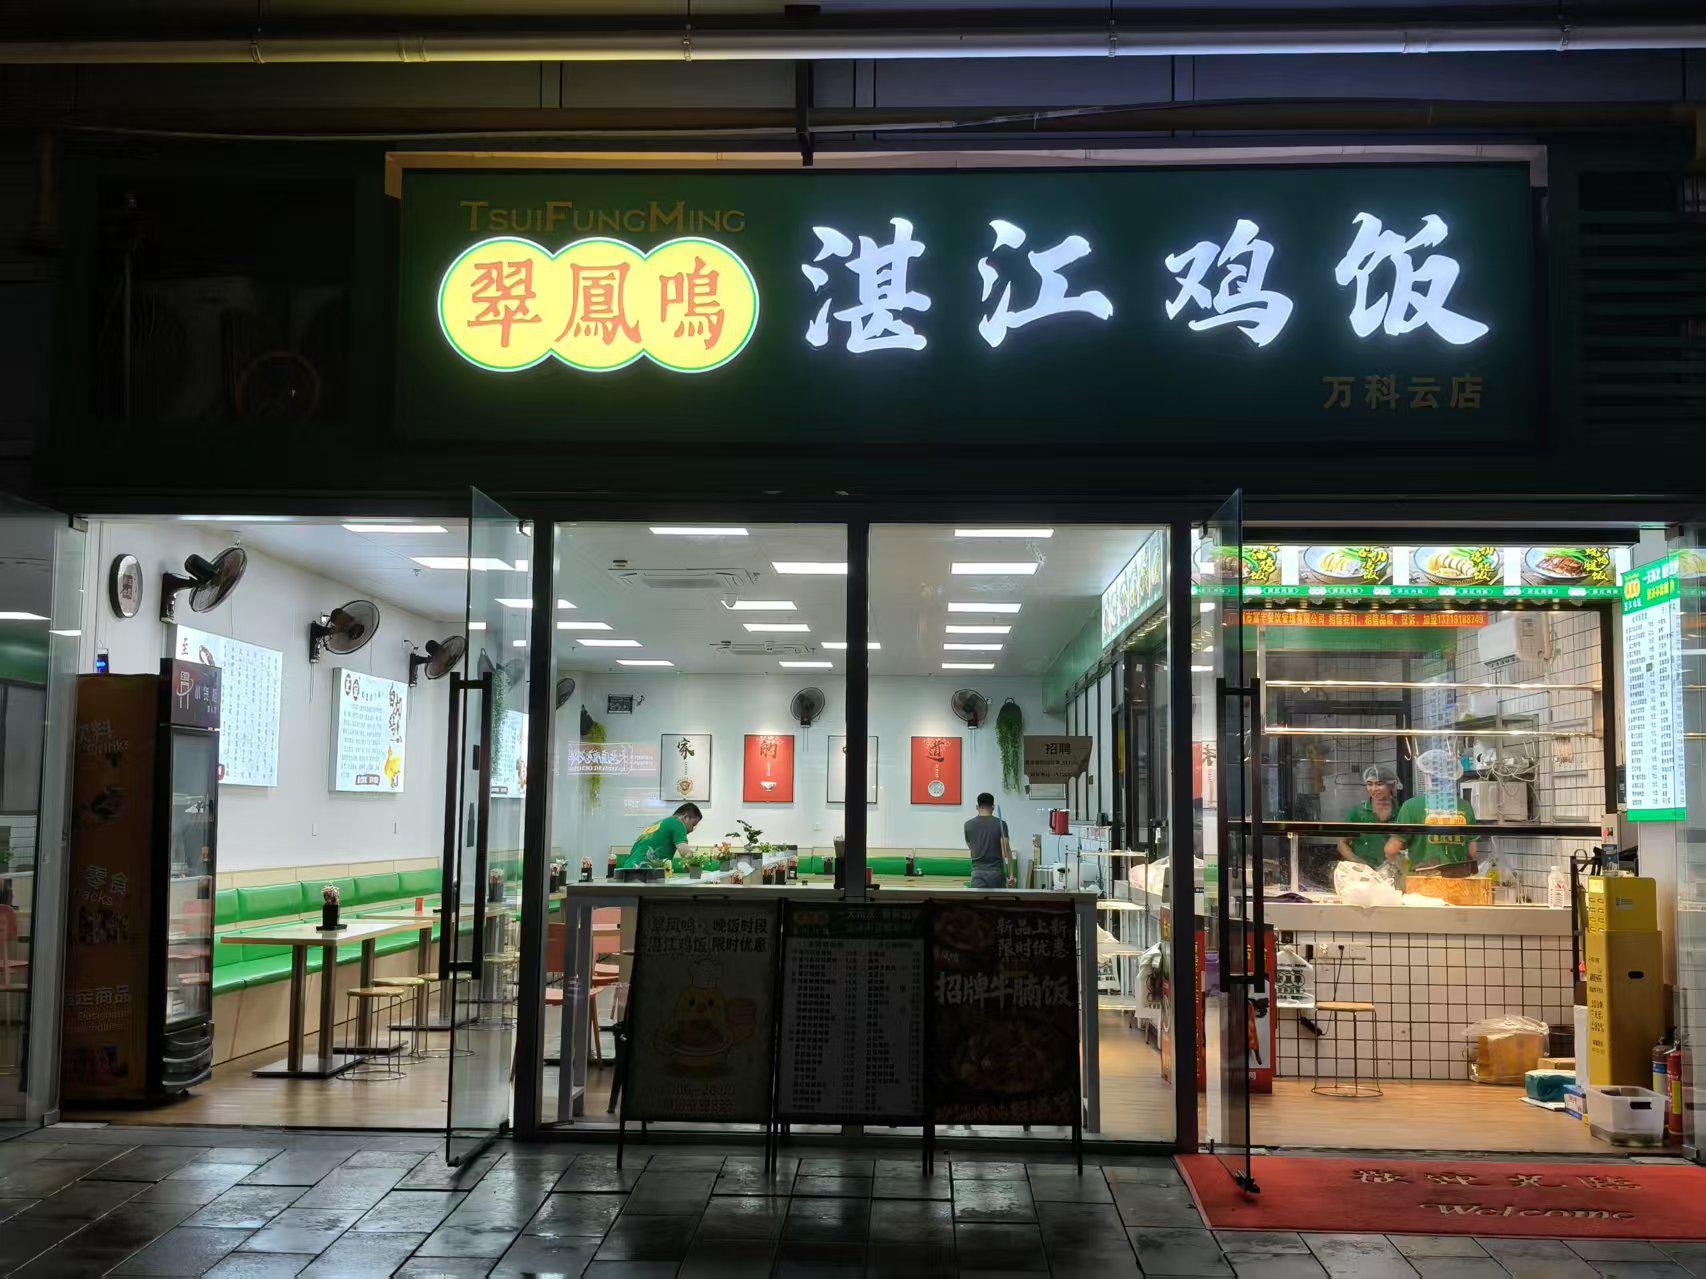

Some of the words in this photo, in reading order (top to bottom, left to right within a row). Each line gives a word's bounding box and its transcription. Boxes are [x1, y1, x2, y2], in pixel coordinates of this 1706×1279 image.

[802, 211, 1490, 354] 湛江鸡饭
[1321, 372, 1483, 410] 万科云店
[1044, 742, 1071, 755] 招聘
[713, 917, 768, 933] 晚饭时段
[996, 918, 1068, 938] 新品上新
[711, 936, 767, 952] 限时优惠
[998, 938, 1069, 958] 限时优惠
[935, 971, 1073, 1009] 招牌牛腩饭
[1418, 1203, 1638, 1221] Welcome
